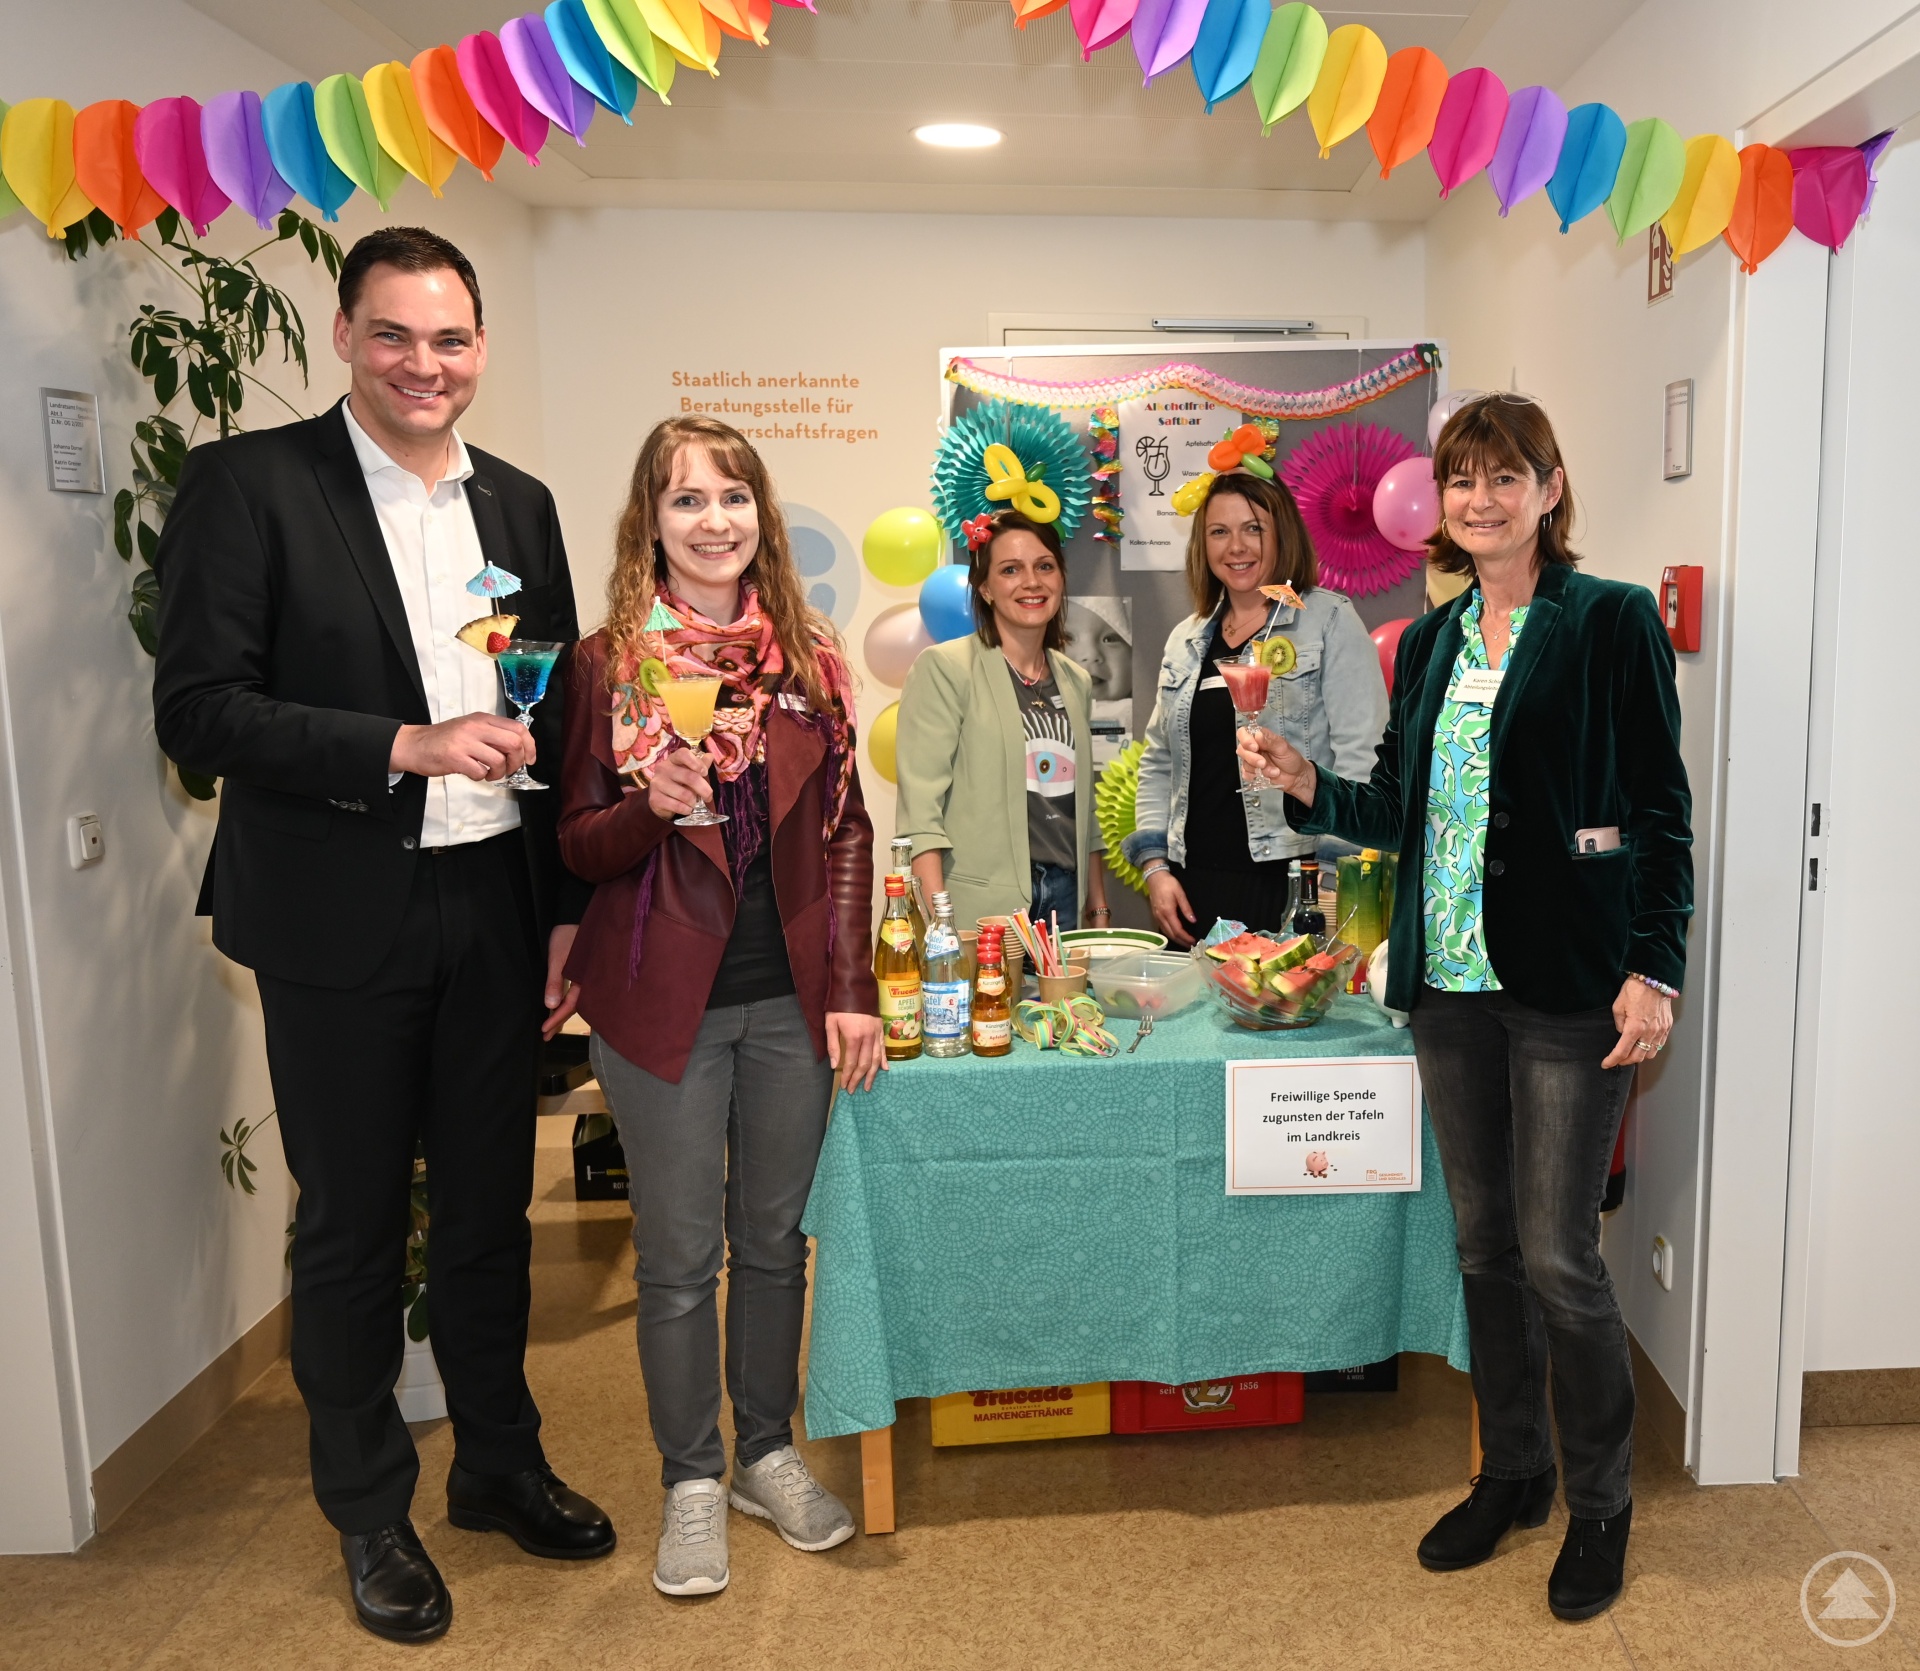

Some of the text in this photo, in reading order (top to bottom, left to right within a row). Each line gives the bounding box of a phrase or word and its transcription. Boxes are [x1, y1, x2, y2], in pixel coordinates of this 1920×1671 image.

[672, 371, 860, 389] Staatlich anerkannte
[680, 397, 854, 418] Beratungsstelle für
[1144, 401, 1216, 412] Alkoholfreie
[1158, 416, 1202, 426] Saftbar
[738, 422, 879, 444] erschaftsfragen
[1270, 1089, 1377, 1104] Freiwillige Spende
[1262, 1108, 1385, 1125] zugunsten der Tafeln
[1287, 1130, 1361, 1143] im Landkreis
[1159, 1385, 1176, 1395] seit
[1239, 1381, 1259, 1391] 1856
[973, 1406, 1074, 1422] MARKENGETRÄNKE
